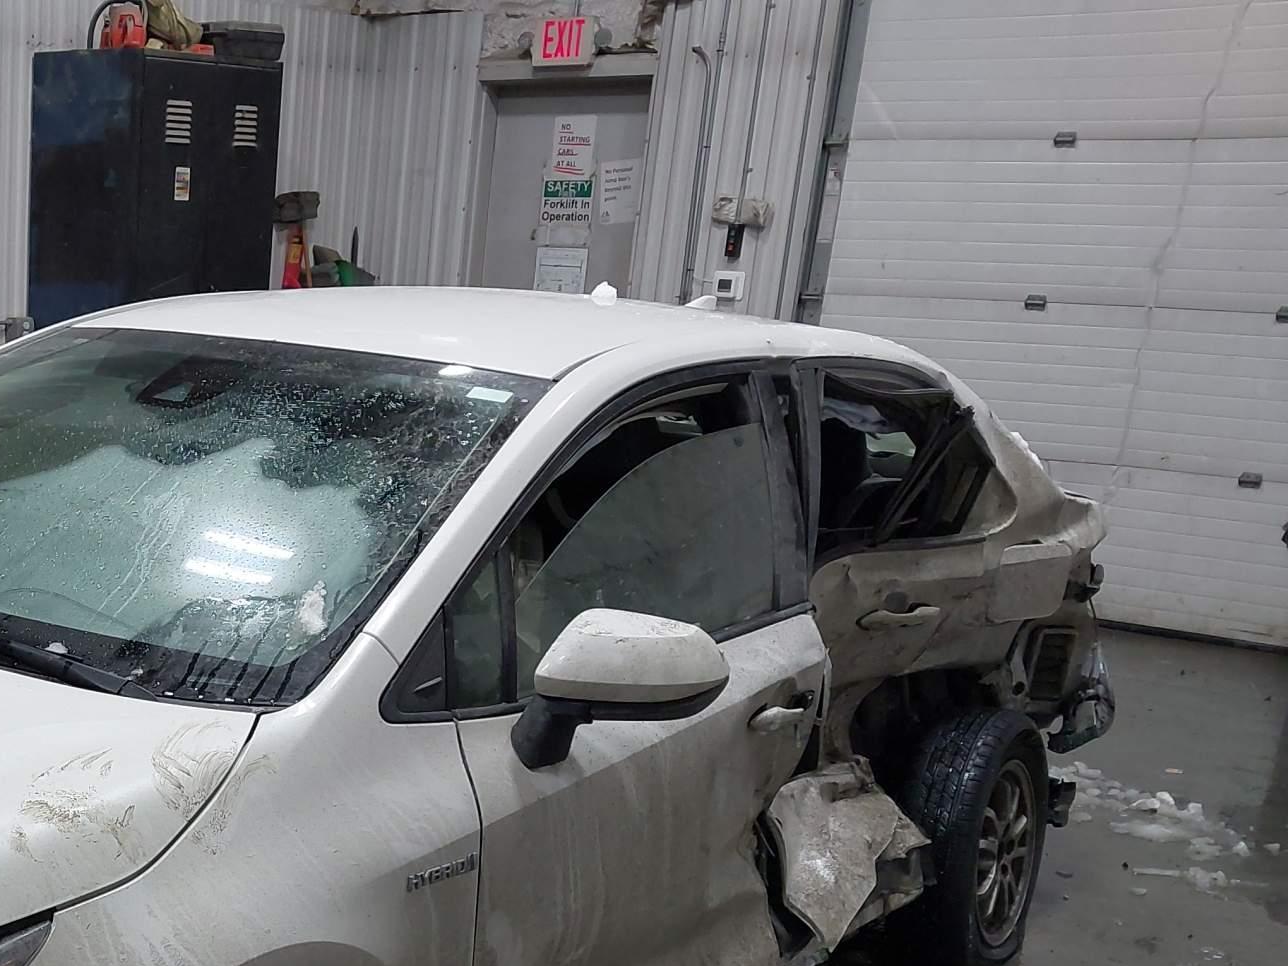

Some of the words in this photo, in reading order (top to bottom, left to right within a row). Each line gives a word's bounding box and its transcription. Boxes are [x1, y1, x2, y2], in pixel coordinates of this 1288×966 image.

[542, 18, 585, 59] EXIT
[561, 123, 571, 131] NO
[559, 135, 591, 143] STARTING
[557, 160, 564, 168] AT
[547, 181, 590, 192] SAFETY
[543, 199, 578, 209] Forklift
[580, 199, 590, 209] In
[541, 211, 590, 224] Operation
[407, 856, 466, 892] HYBRID
